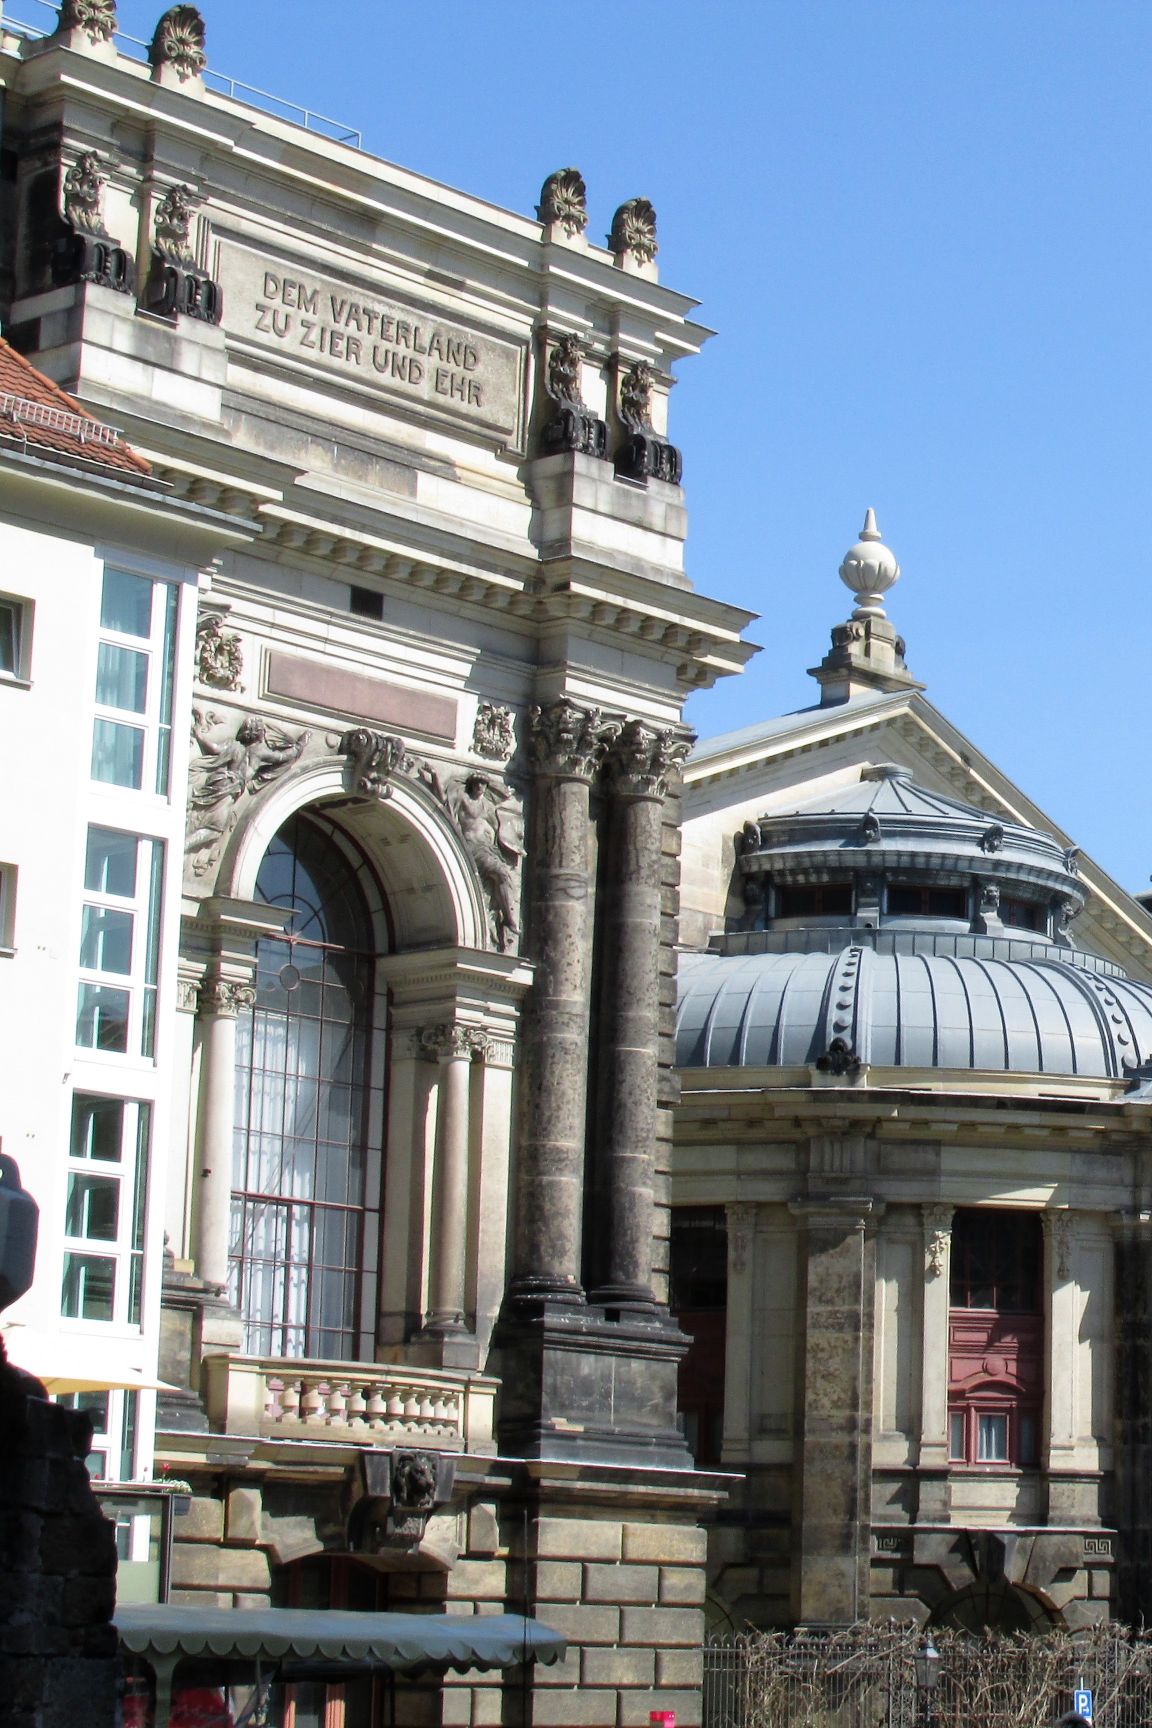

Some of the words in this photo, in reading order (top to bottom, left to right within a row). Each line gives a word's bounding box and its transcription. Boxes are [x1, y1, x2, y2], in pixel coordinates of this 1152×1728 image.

[255, 303, 291, 338] ZU
[301, 319, 363, 365] ZIER
[373, 346, 425, 385] UND
[435, 367, 484, 407] EHR
[264, 271, 320, 315] DEM
[330, 294, 481, 371] VATERLAND
[1078, 1694, 1088, 1715] P
